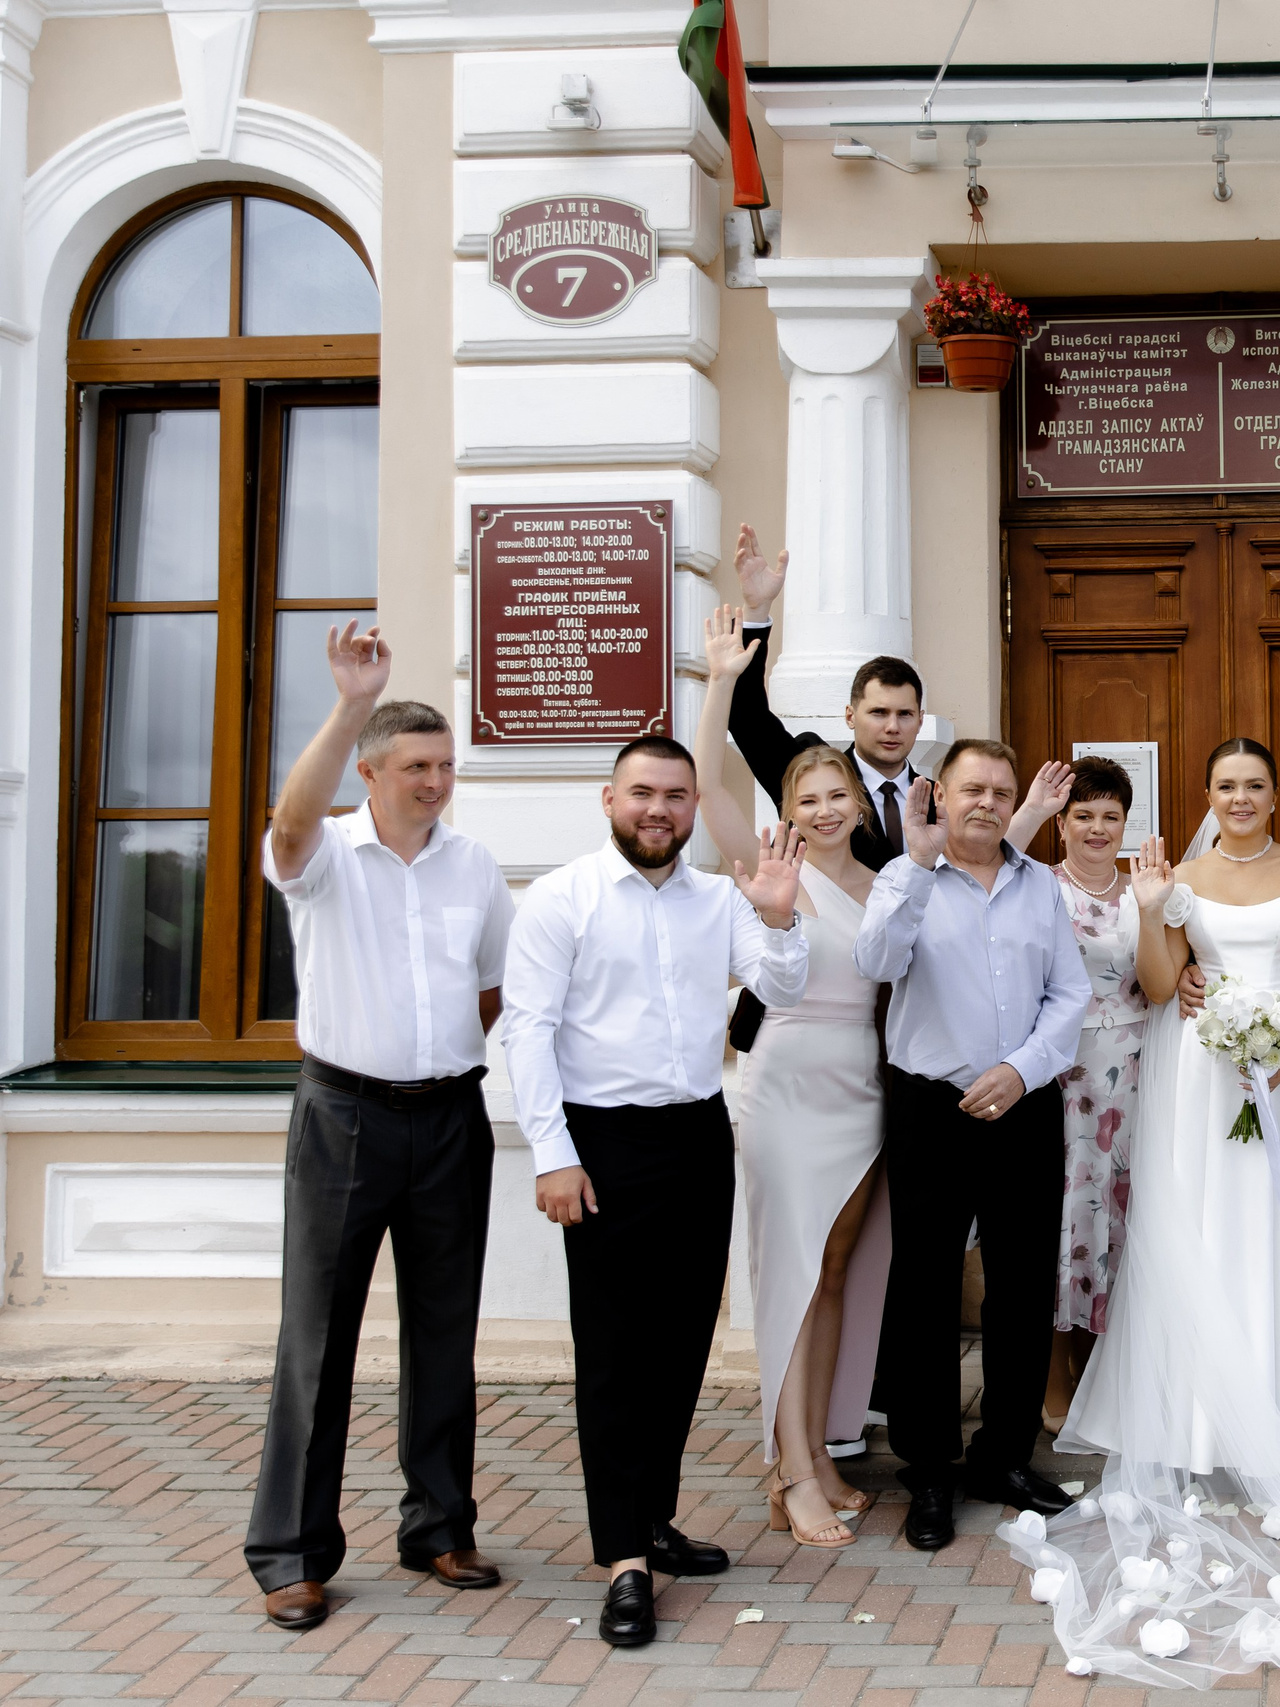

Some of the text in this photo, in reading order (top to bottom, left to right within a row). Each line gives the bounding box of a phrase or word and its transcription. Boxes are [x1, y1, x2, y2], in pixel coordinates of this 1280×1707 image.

[545, 202, 600, 219] улица
[497, 219, 649, 263] СРЕДНЕНАБЕРЕЖНАЯ
[558, 267, 587, 307] 7
[1051, 332, 1180, 347] Віцебскі гарадскі
[1045, 347, 1188, 362] выканаўчы камітэт
[1060, 367, 1171, 381] Адміністрацыя
[1045, 381, 1188, 397] Чыгуначнага раёна
[1038, 413, 1204, 438] АДДЗЕЛ ЗАПІСУ АКТАЎ
[1057, 437, 1185, 456] ГРАМАДЗЯНСКАГА
[1099, 458, 1143, 473] СТАНУ
[514, 519, 632, 532] РЕЖИМ РАБОТЫ:
[524, 537, 577, 548] 08.00-13.00;
[582, 535, 632, 546] 14.00-20.00
[544, 551, 596, 562] 08.00-13.00;
[602, 549, 649, 561] 14.00-17.00
[538, 567, 606, 576] ВЫХОДНЫЕ ДНИ:
[512, 577, 632, 587] ВОСКРЕСЕНЬЕ, ПОНЕДЕЛЬНИК
[518, 589, 626, 603] ГРАФИК ПРИЁМА
[504, 604, 640, 616] ЗАИНТЕРЕСОВАННЫХ
[557, 618, 587, 628] ЛИЦ:
[497, 633, 532, 641] ВТОРНИК:
[591, 628, 648, 640] 14.00-20.00
[497, 642, 641, 655] СРЕДА: 08.00-13.00; 14.00-17.00
[497, 657, 588, 669] ЧЕТВЕРГ: 08.00-13.00
[497, 670, 593, 683] ПЯТНИЦА: 08.00-09.00
[497, 684, 593, 696] СУББОТА: 08.00-09.00
[555, 721, 585, 729] вопросам
